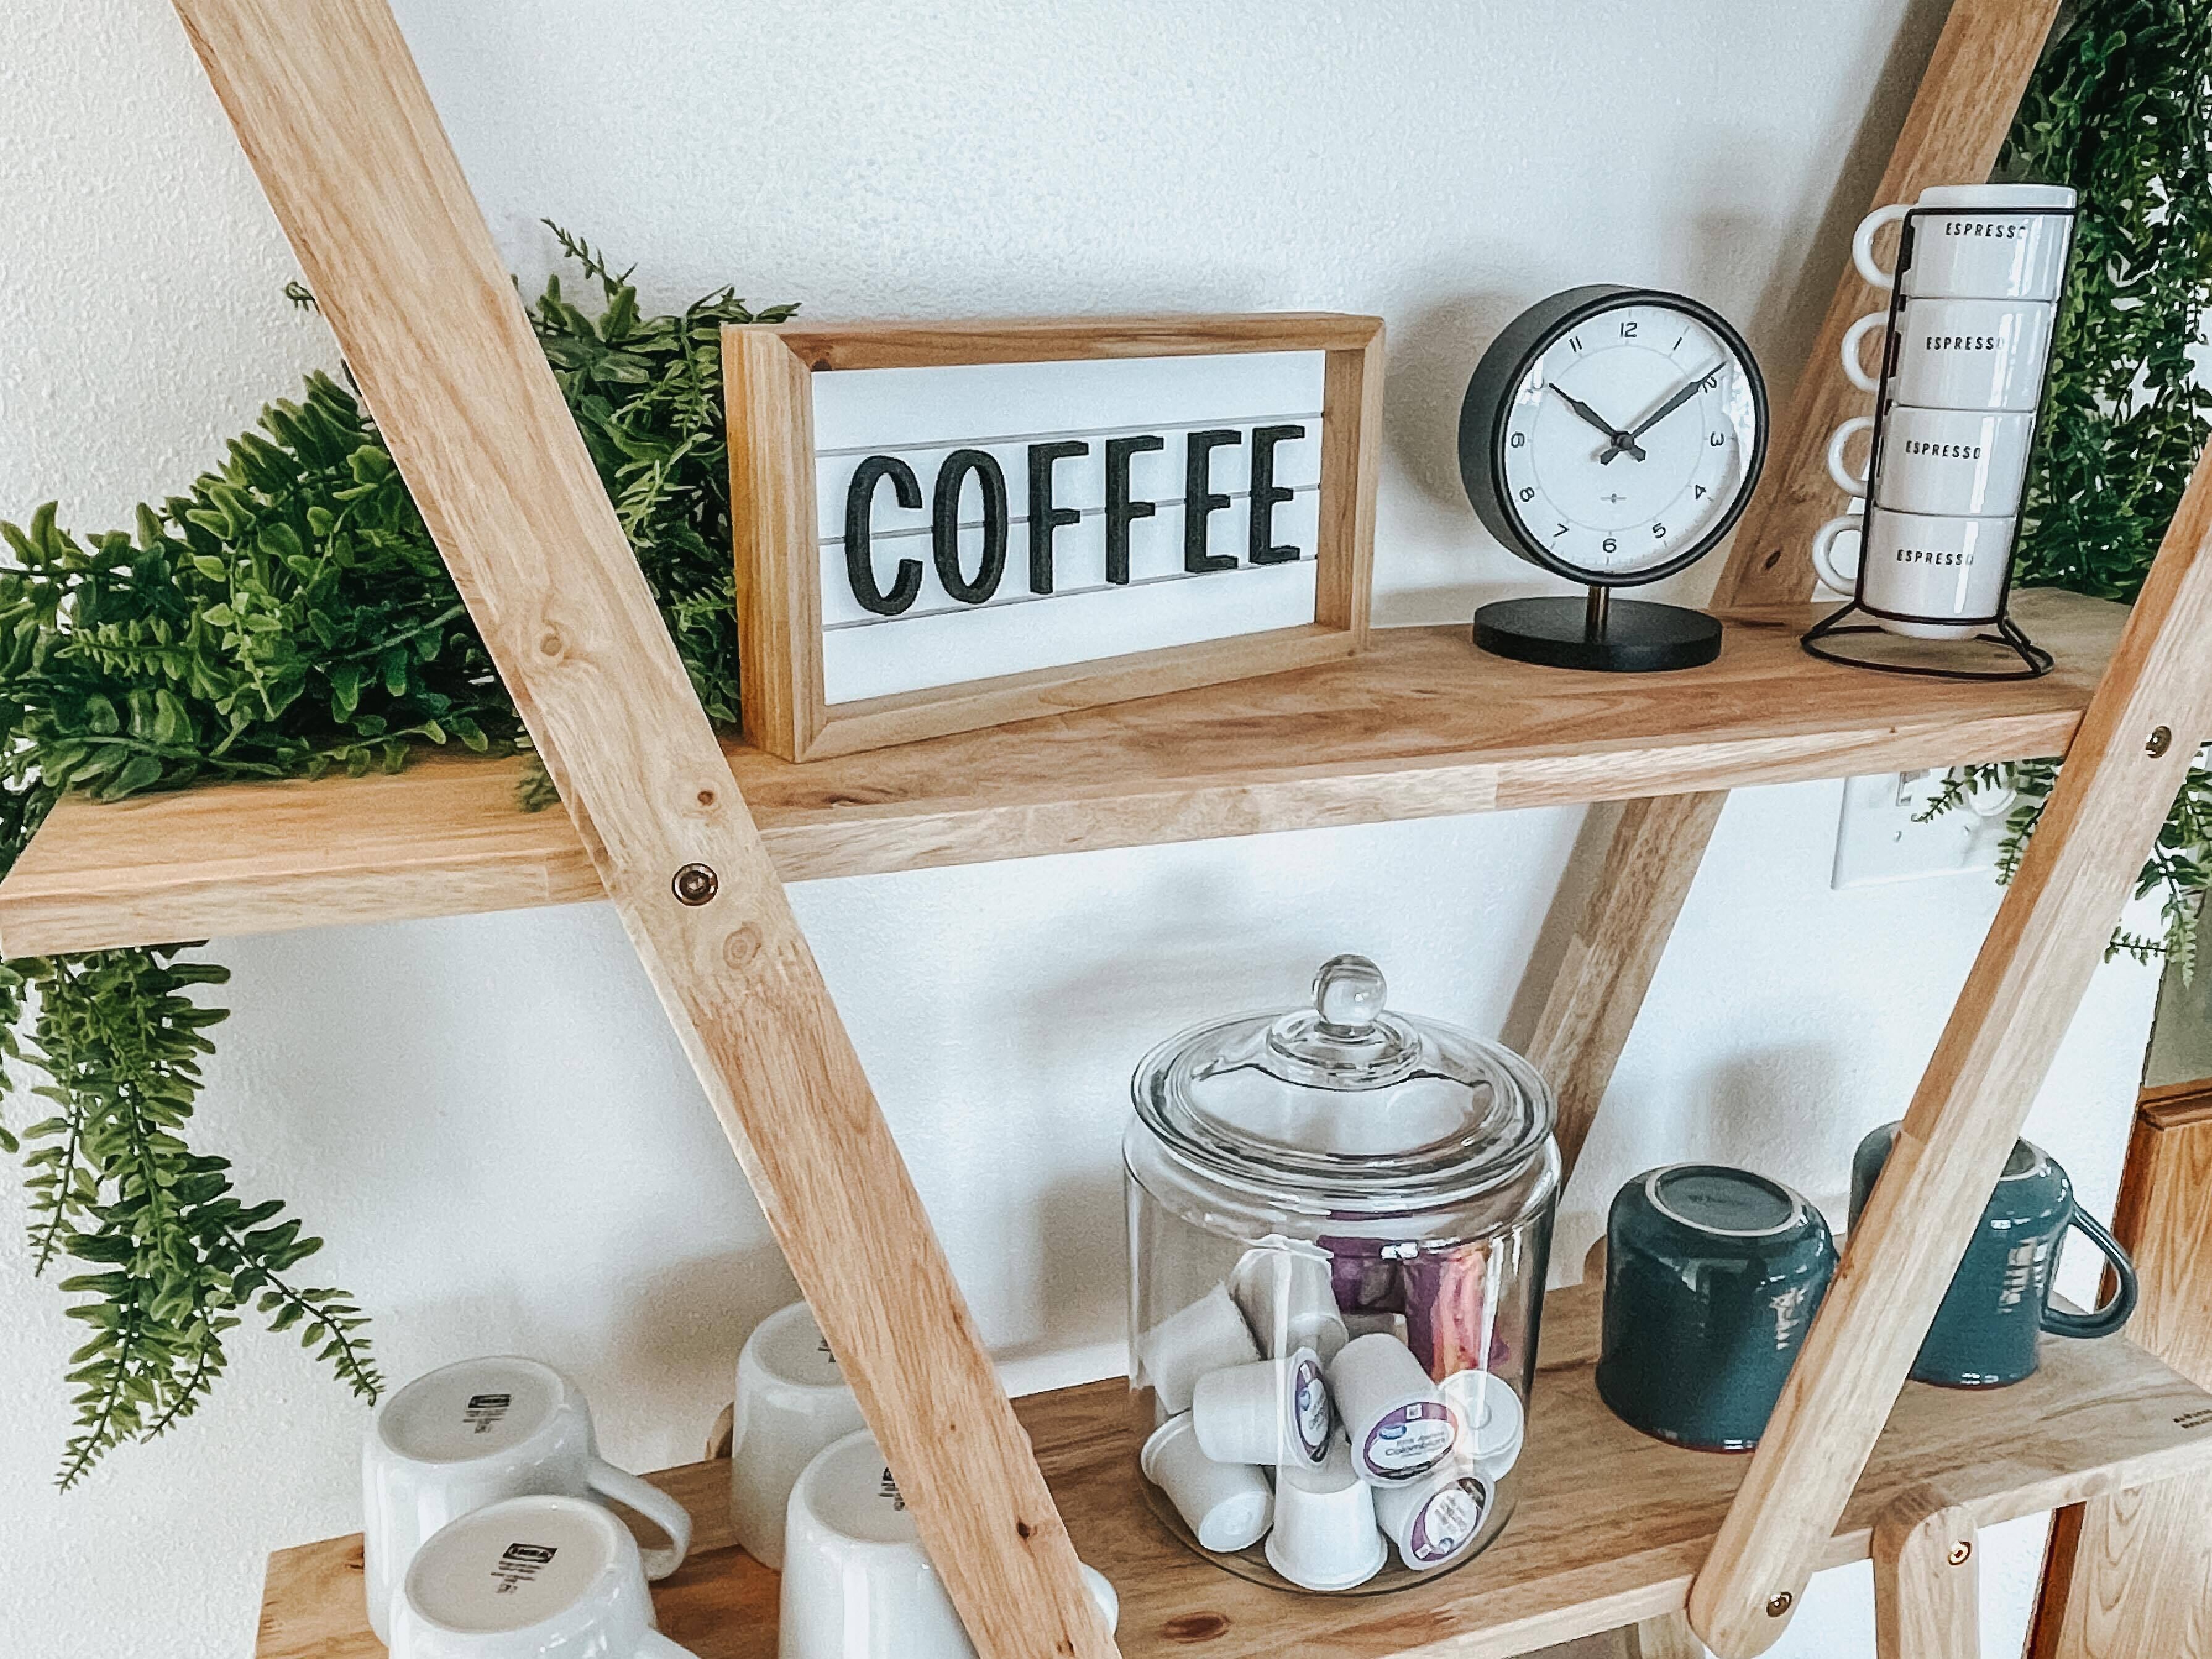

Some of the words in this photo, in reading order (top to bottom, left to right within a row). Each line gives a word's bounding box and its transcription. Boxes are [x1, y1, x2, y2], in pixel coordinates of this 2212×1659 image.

[1619, 322, 1637, 338] 12
[1568, 335, 1583, 353] 11
[1672, 336, 1684, 352] 1
[1926, 336, 2005, 350] ESPRESSO
[1510, 431, 1526, 448] 9
[1710, 431, 1725, 447] 3
[1905, 440, 1981, 459] ESPRESSO
[1519, 486, 1536, 503] 8
[1693, 483, 1707, 500] 4
[844, 425, 1305, 616] COFFEE
[1553, 524, 1570, 538] 7
[1651, 522, 1667, 540] 5
[1602, 538, 1617, 554] 6
[1896, 549, 1973, 566] ESPRESSO
